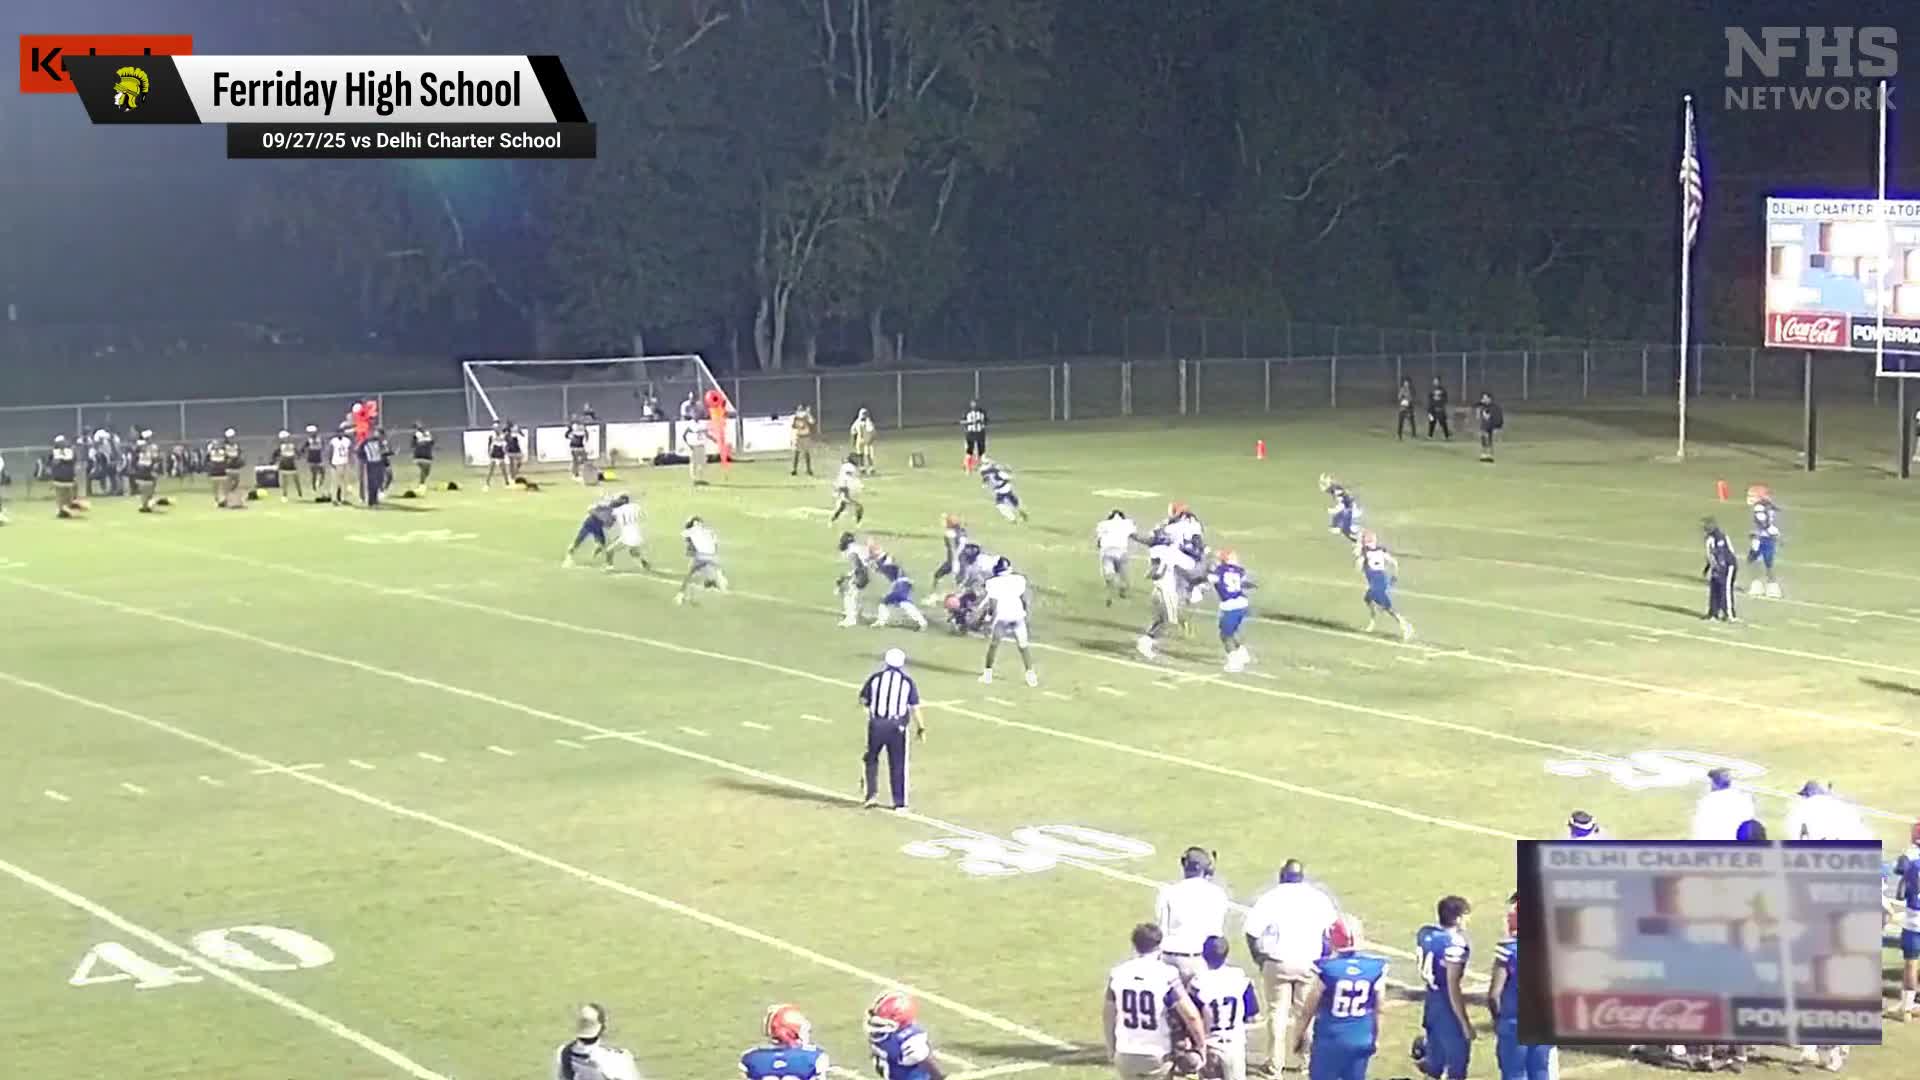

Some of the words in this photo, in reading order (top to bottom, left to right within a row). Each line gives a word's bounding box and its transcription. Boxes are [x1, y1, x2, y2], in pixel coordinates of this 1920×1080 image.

[1813, 203, 1873, 216] CHARTER
[68, 925, 335, 990] 40
[1122, 988, 1158, 1030] 99
[1210, 996, 1238, 1031] 17
[1331, 980, 1370, 1017] 62
